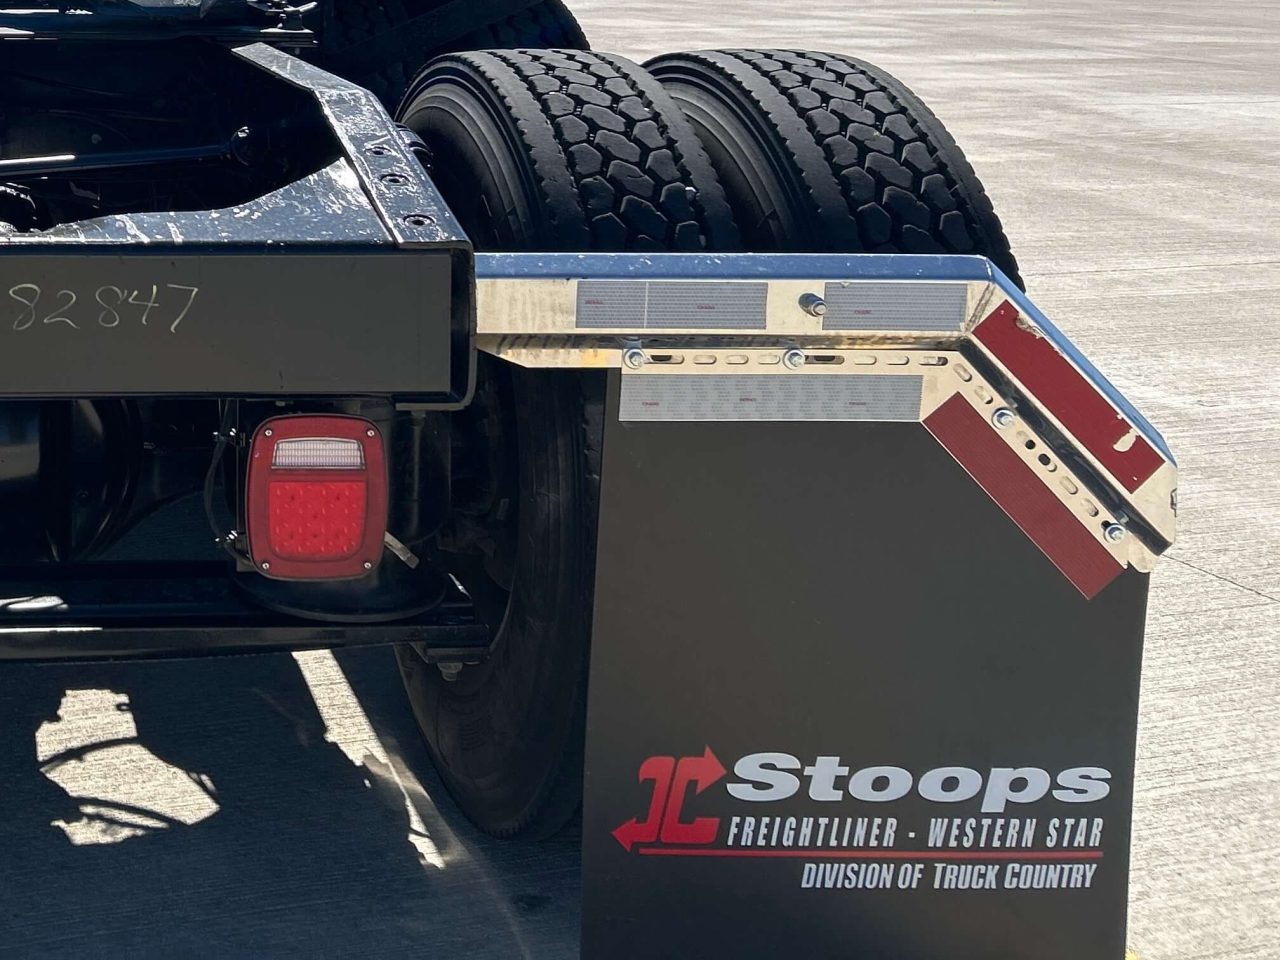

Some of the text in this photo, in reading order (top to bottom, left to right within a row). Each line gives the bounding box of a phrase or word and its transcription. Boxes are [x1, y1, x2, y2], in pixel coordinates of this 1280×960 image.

[726, 753, 1112, 813] Stoops
[727, 816, 898, 848] FREIGHTLINER
[927, 817, 1037, 848] WESTERN
[1045, 817, 1104, 848] STAR
[801, 862, 1098, 889] DIVISION OF TRUCK COUNTRY
